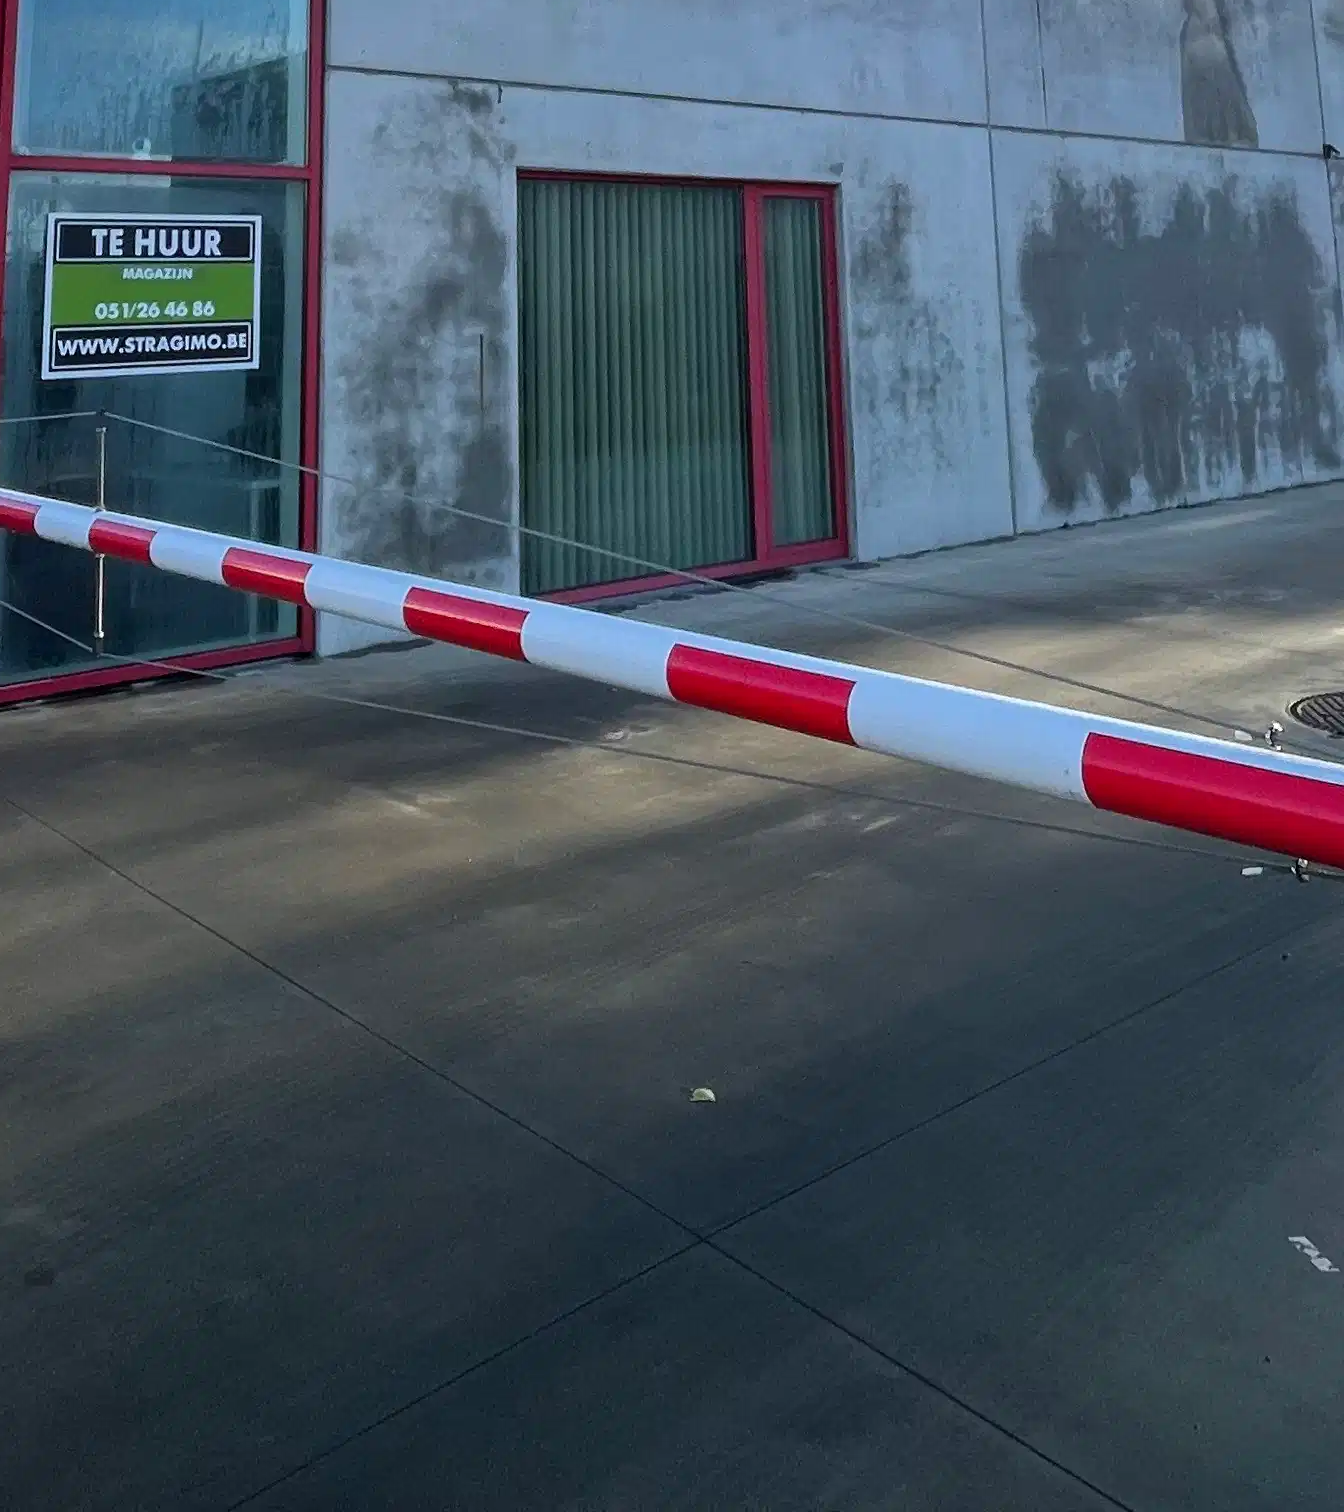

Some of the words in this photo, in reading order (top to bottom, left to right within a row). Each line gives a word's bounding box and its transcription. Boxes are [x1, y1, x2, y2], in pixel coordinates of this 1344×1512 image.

[91, 228, 124, 257] TE
[134, 228, 222, 257] HUUR
[122, 267, 193, 280] MAGAZIJN
[94, 302, 160, 320] 051/26
[164, 301, 188, 317] 46
[192, 300, 215, 317] 86
[57, 332, 247, 357] WWW.STRAGIMO.BE
